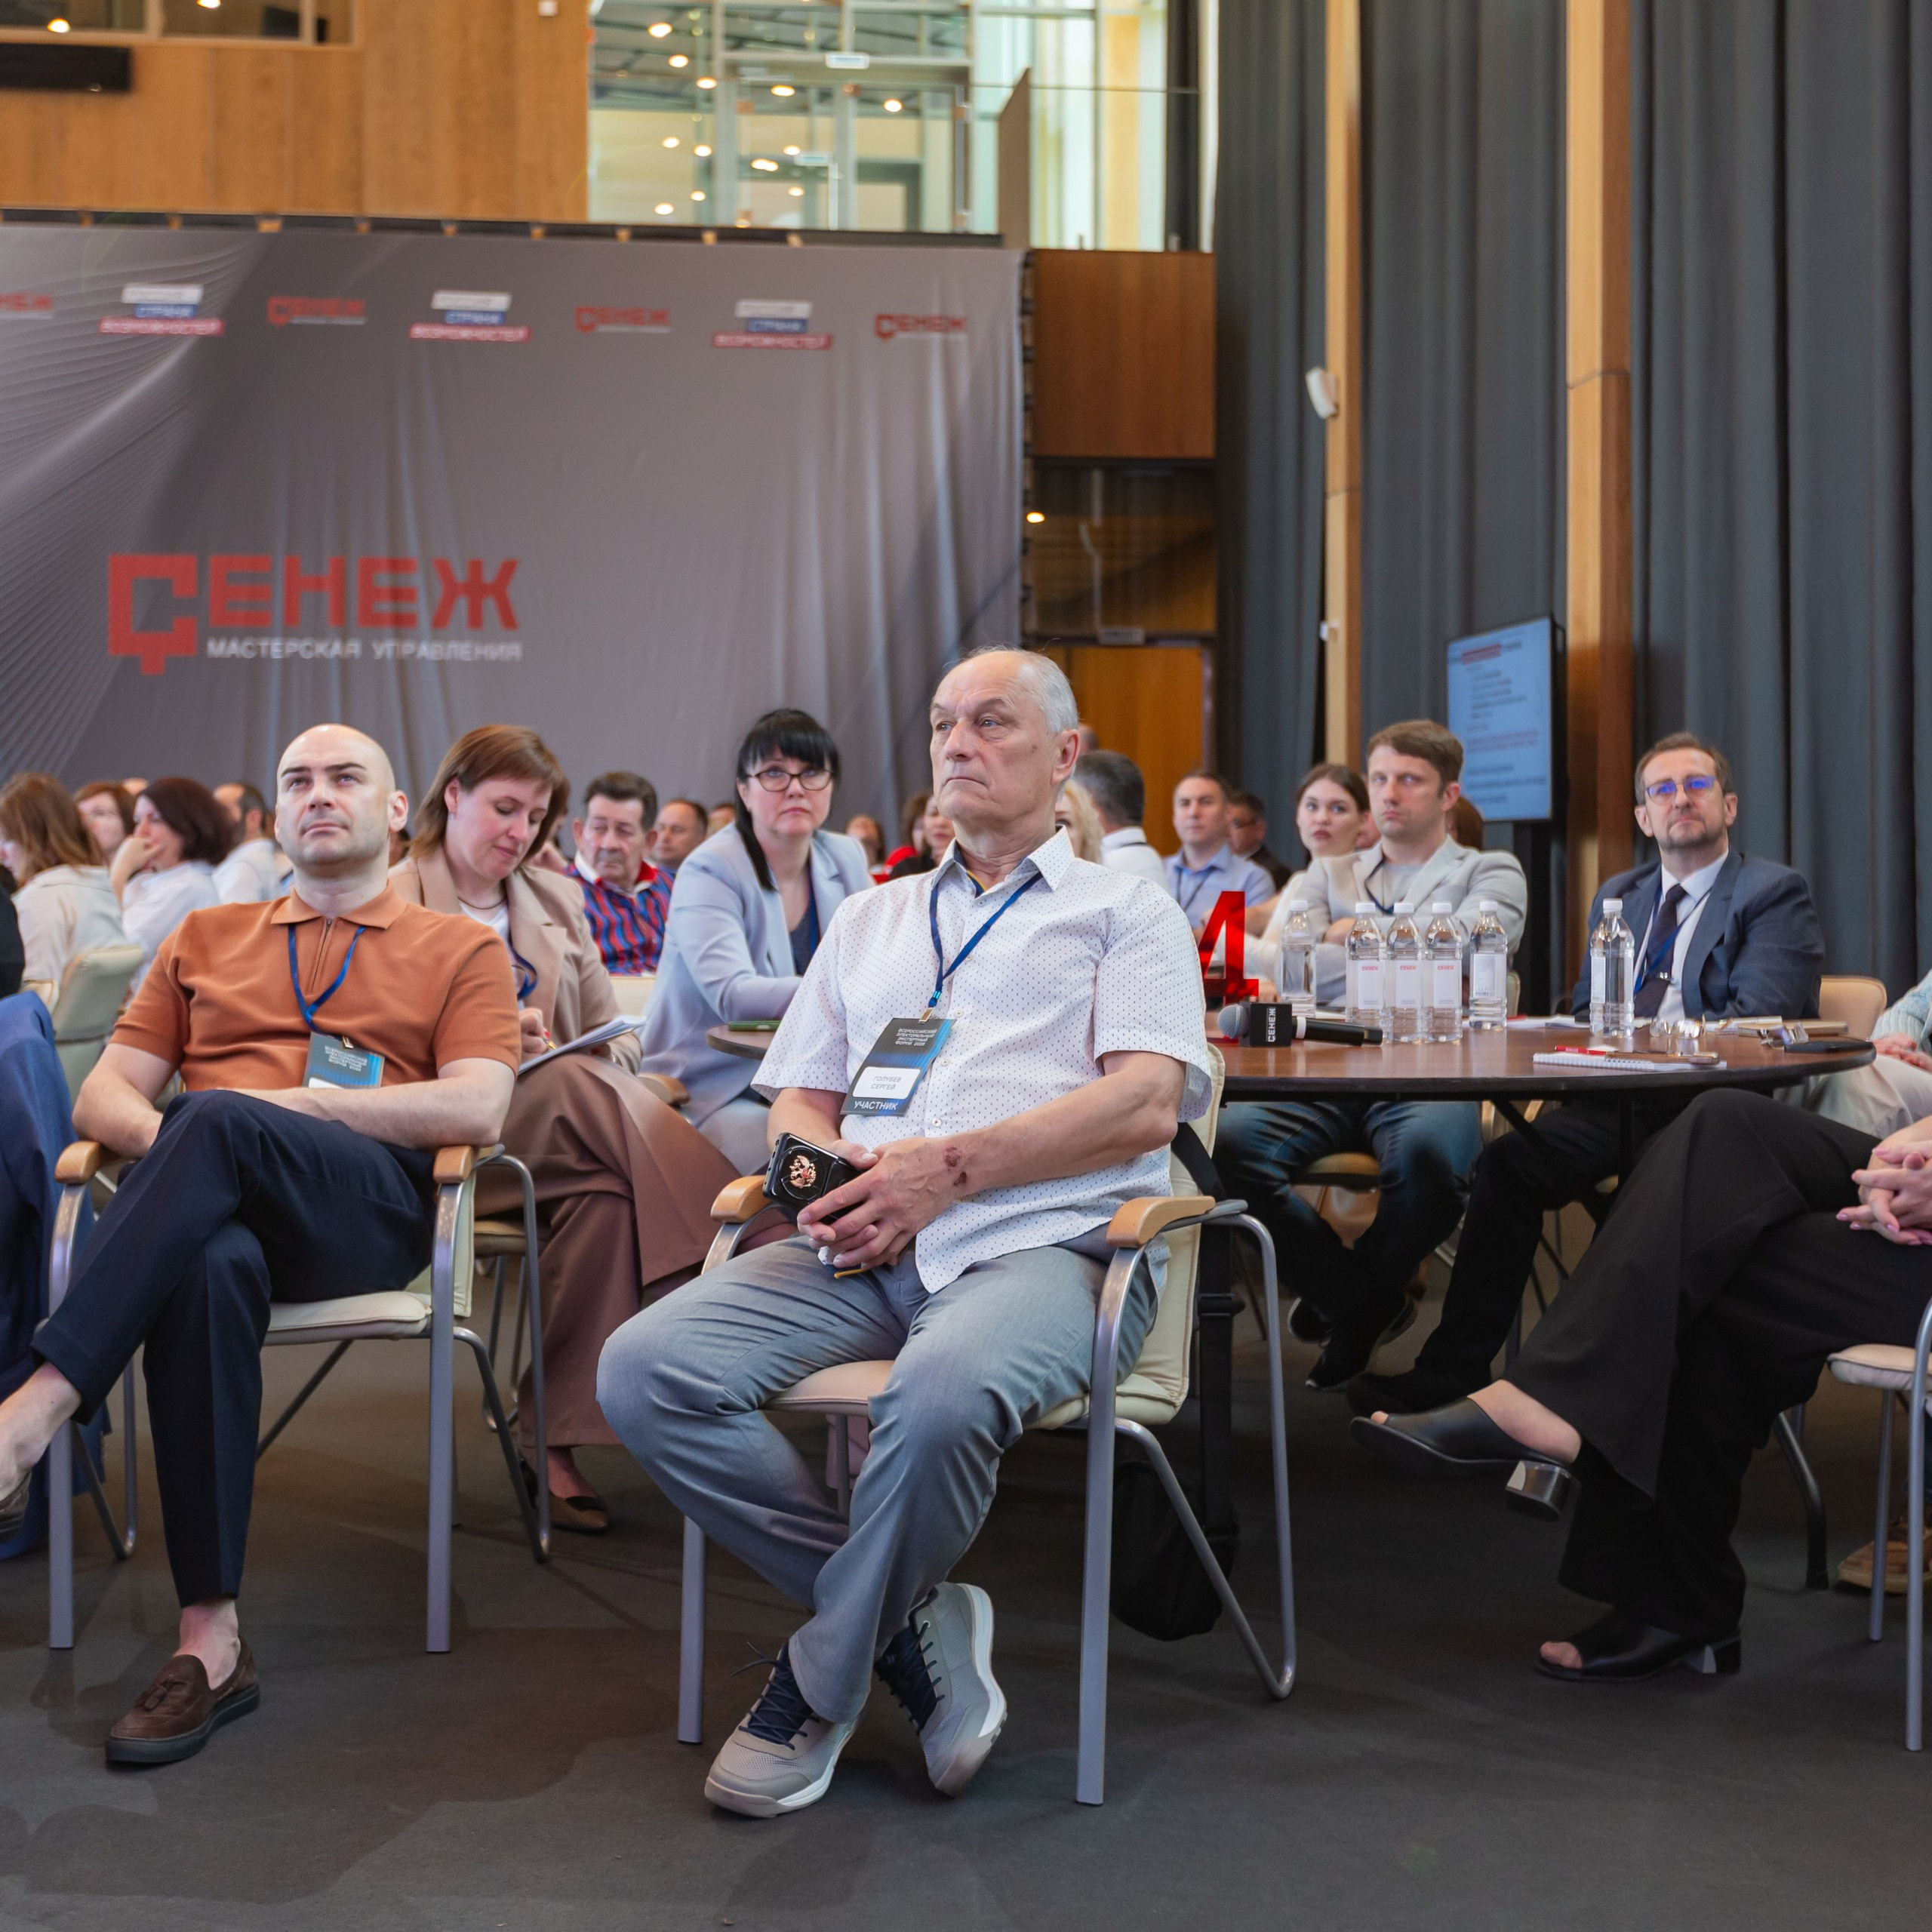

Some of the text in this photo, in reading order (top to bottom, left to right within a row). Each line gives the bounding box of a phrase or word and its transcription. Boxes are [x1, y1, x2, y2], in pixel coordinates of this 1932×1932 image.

[108, 553, 520, 675] СЕНЕЖ
[206, 635, 524, 662] МАСТЕРСКАЯ УПРАВЛЕНИЯ
[1268, 1007, 1276, 1042] СЕНЕЖ
[854, 1101, 898, 1110] УЧАСТНИК
